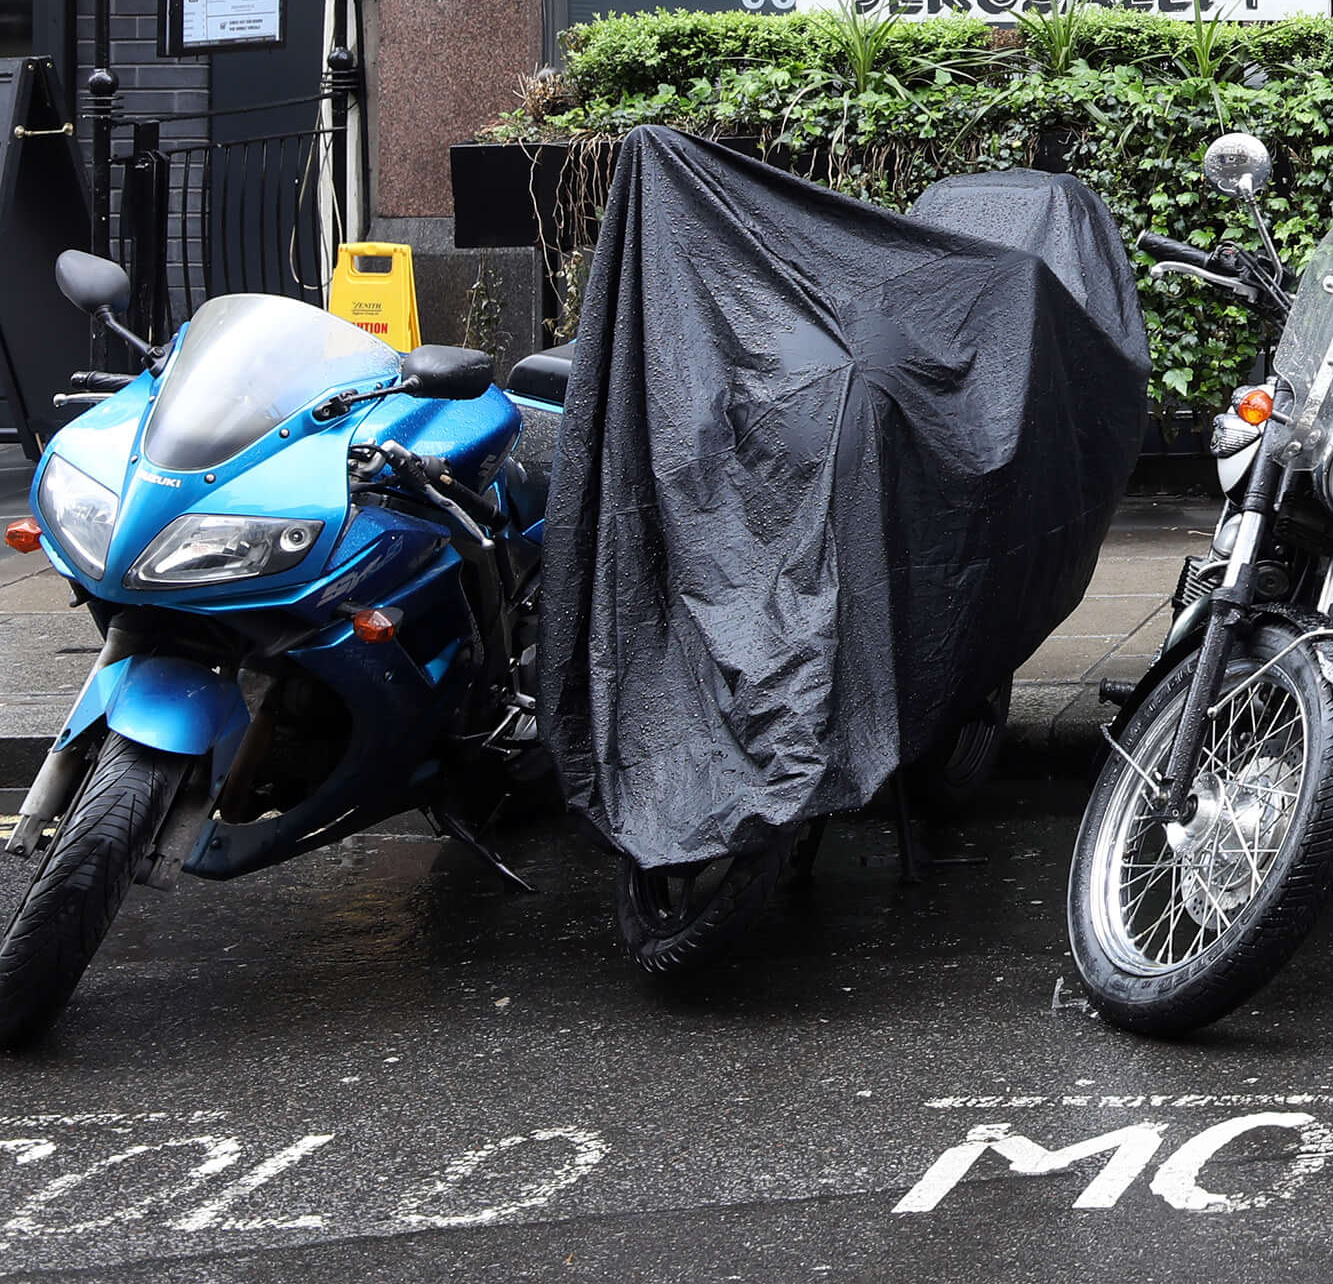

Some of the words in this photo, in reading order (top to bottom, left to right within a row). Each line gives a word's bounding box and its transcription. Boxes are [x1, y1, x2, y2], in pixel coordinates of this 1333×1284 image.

[352, 301, 382, 309] ZENITH
[351, 322, 388, 334] UTION
[0, 1114, 606, 1246] OLO
